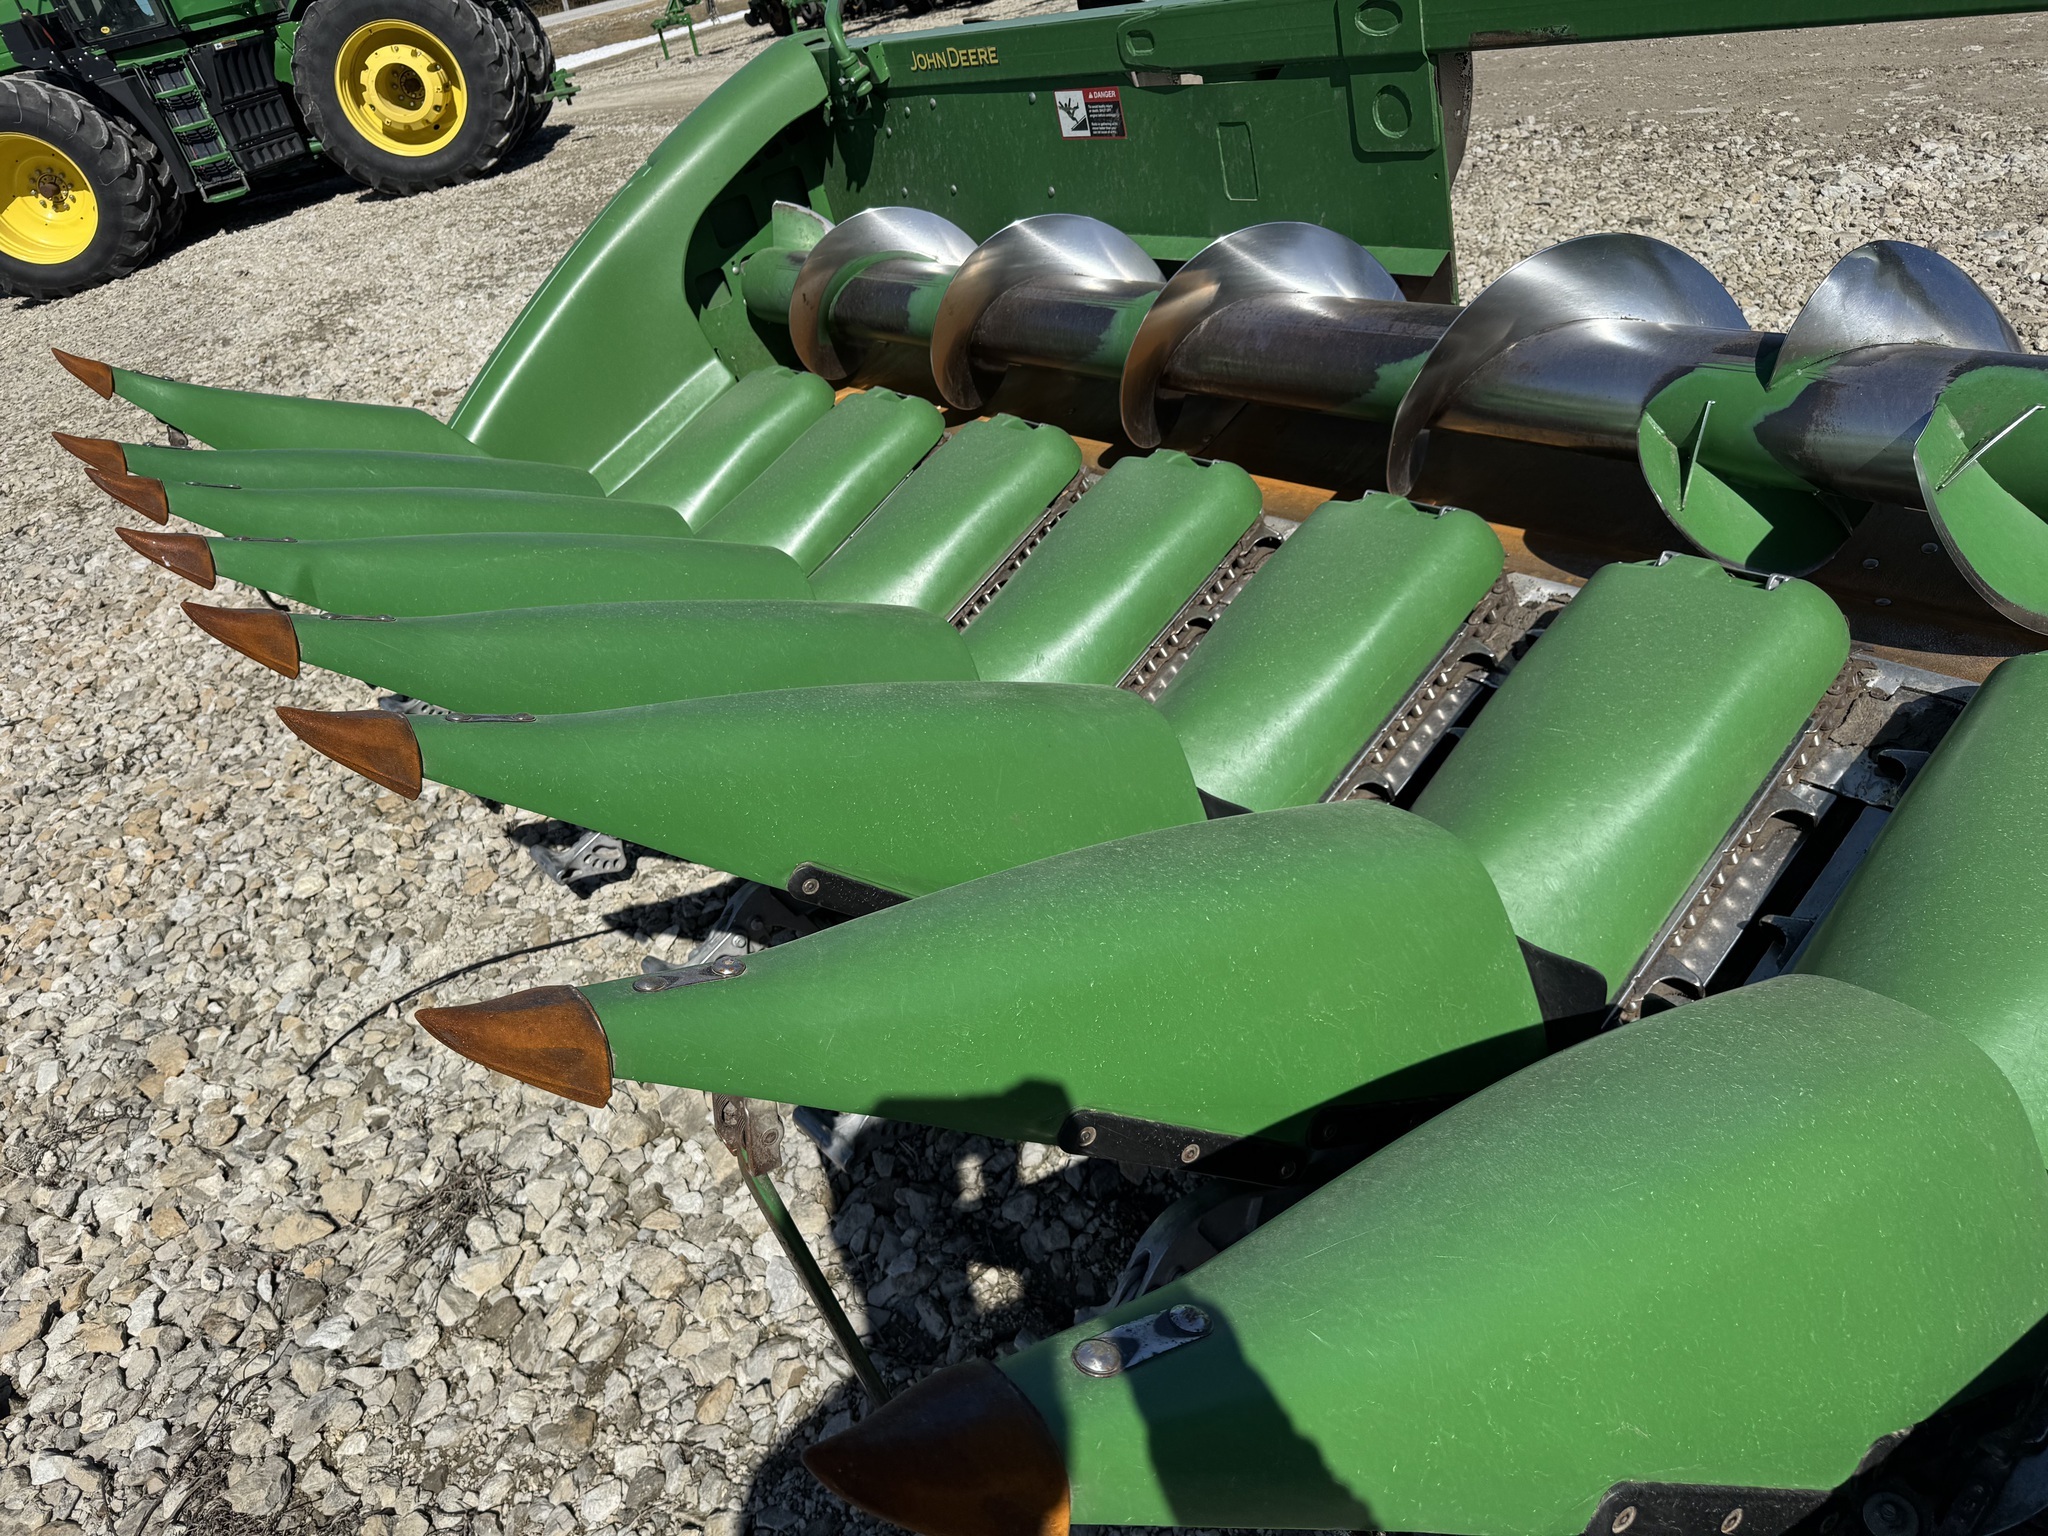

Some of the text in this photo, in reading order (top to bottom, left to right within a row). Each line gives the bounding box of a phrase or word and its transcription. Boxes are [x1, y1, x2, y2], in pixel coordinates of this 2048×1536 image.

[910, 47, 999, 71] JOHN DEERE
[1093, 91, 1116, 99] DANGER
